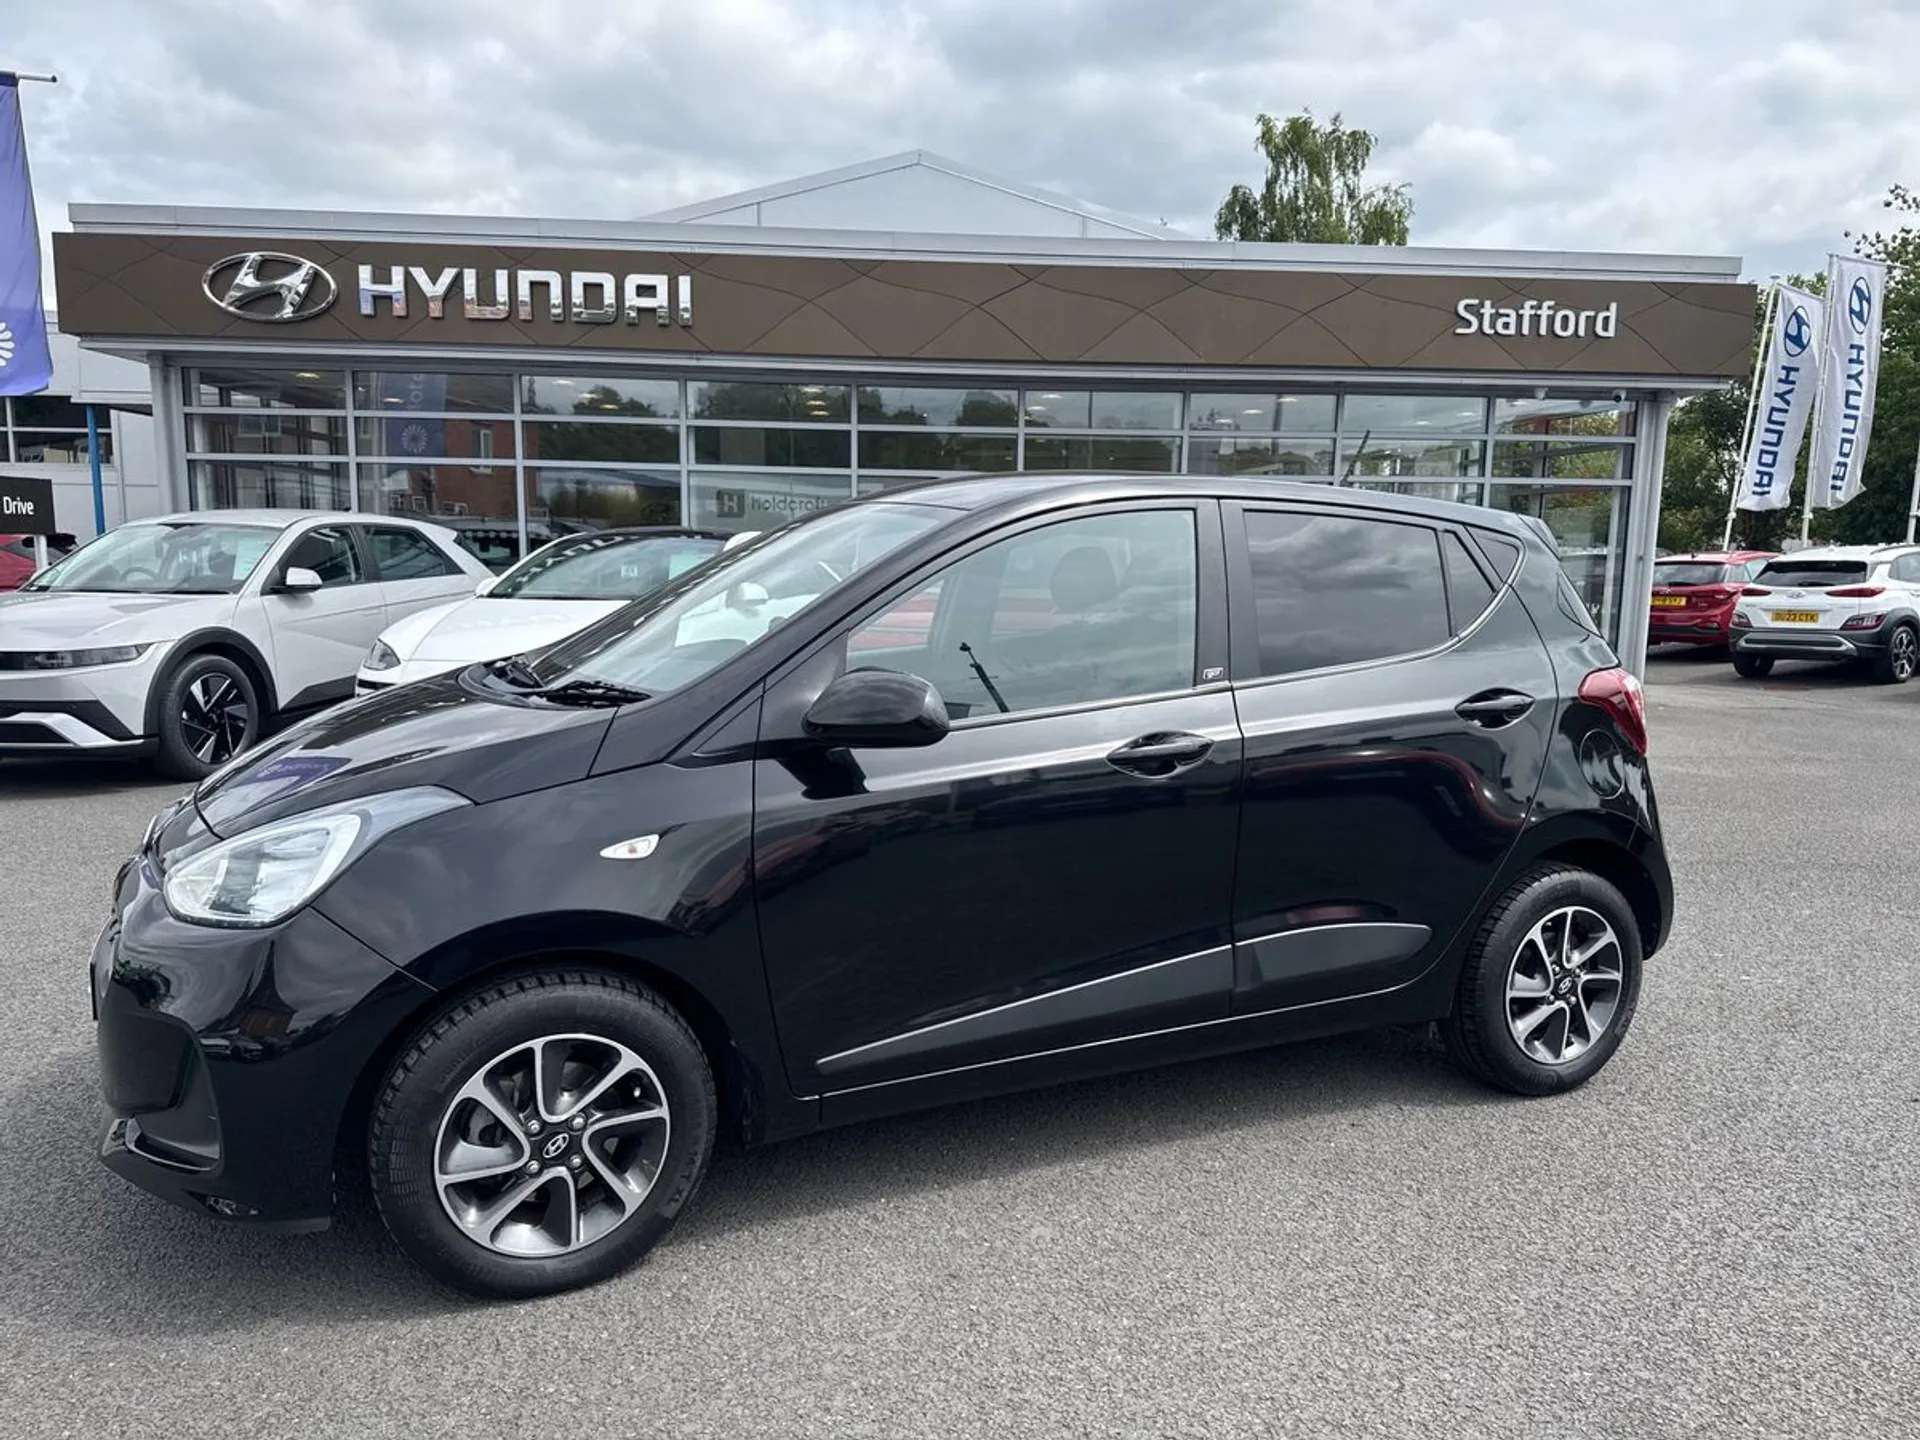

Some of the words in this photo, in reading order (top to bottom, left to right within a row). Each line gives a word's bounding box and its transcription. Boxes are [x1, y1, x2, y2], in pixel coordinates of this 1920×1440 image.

[357, 263, 694, 327] HYUNDAI
[1454, 298, 1618, 338] Stafford
[1751, 364, 1800, 497] HYUNDAI
[1829, 343, 1866, 492] HYUNDAI
[3, 495, 35, 515] Drive
